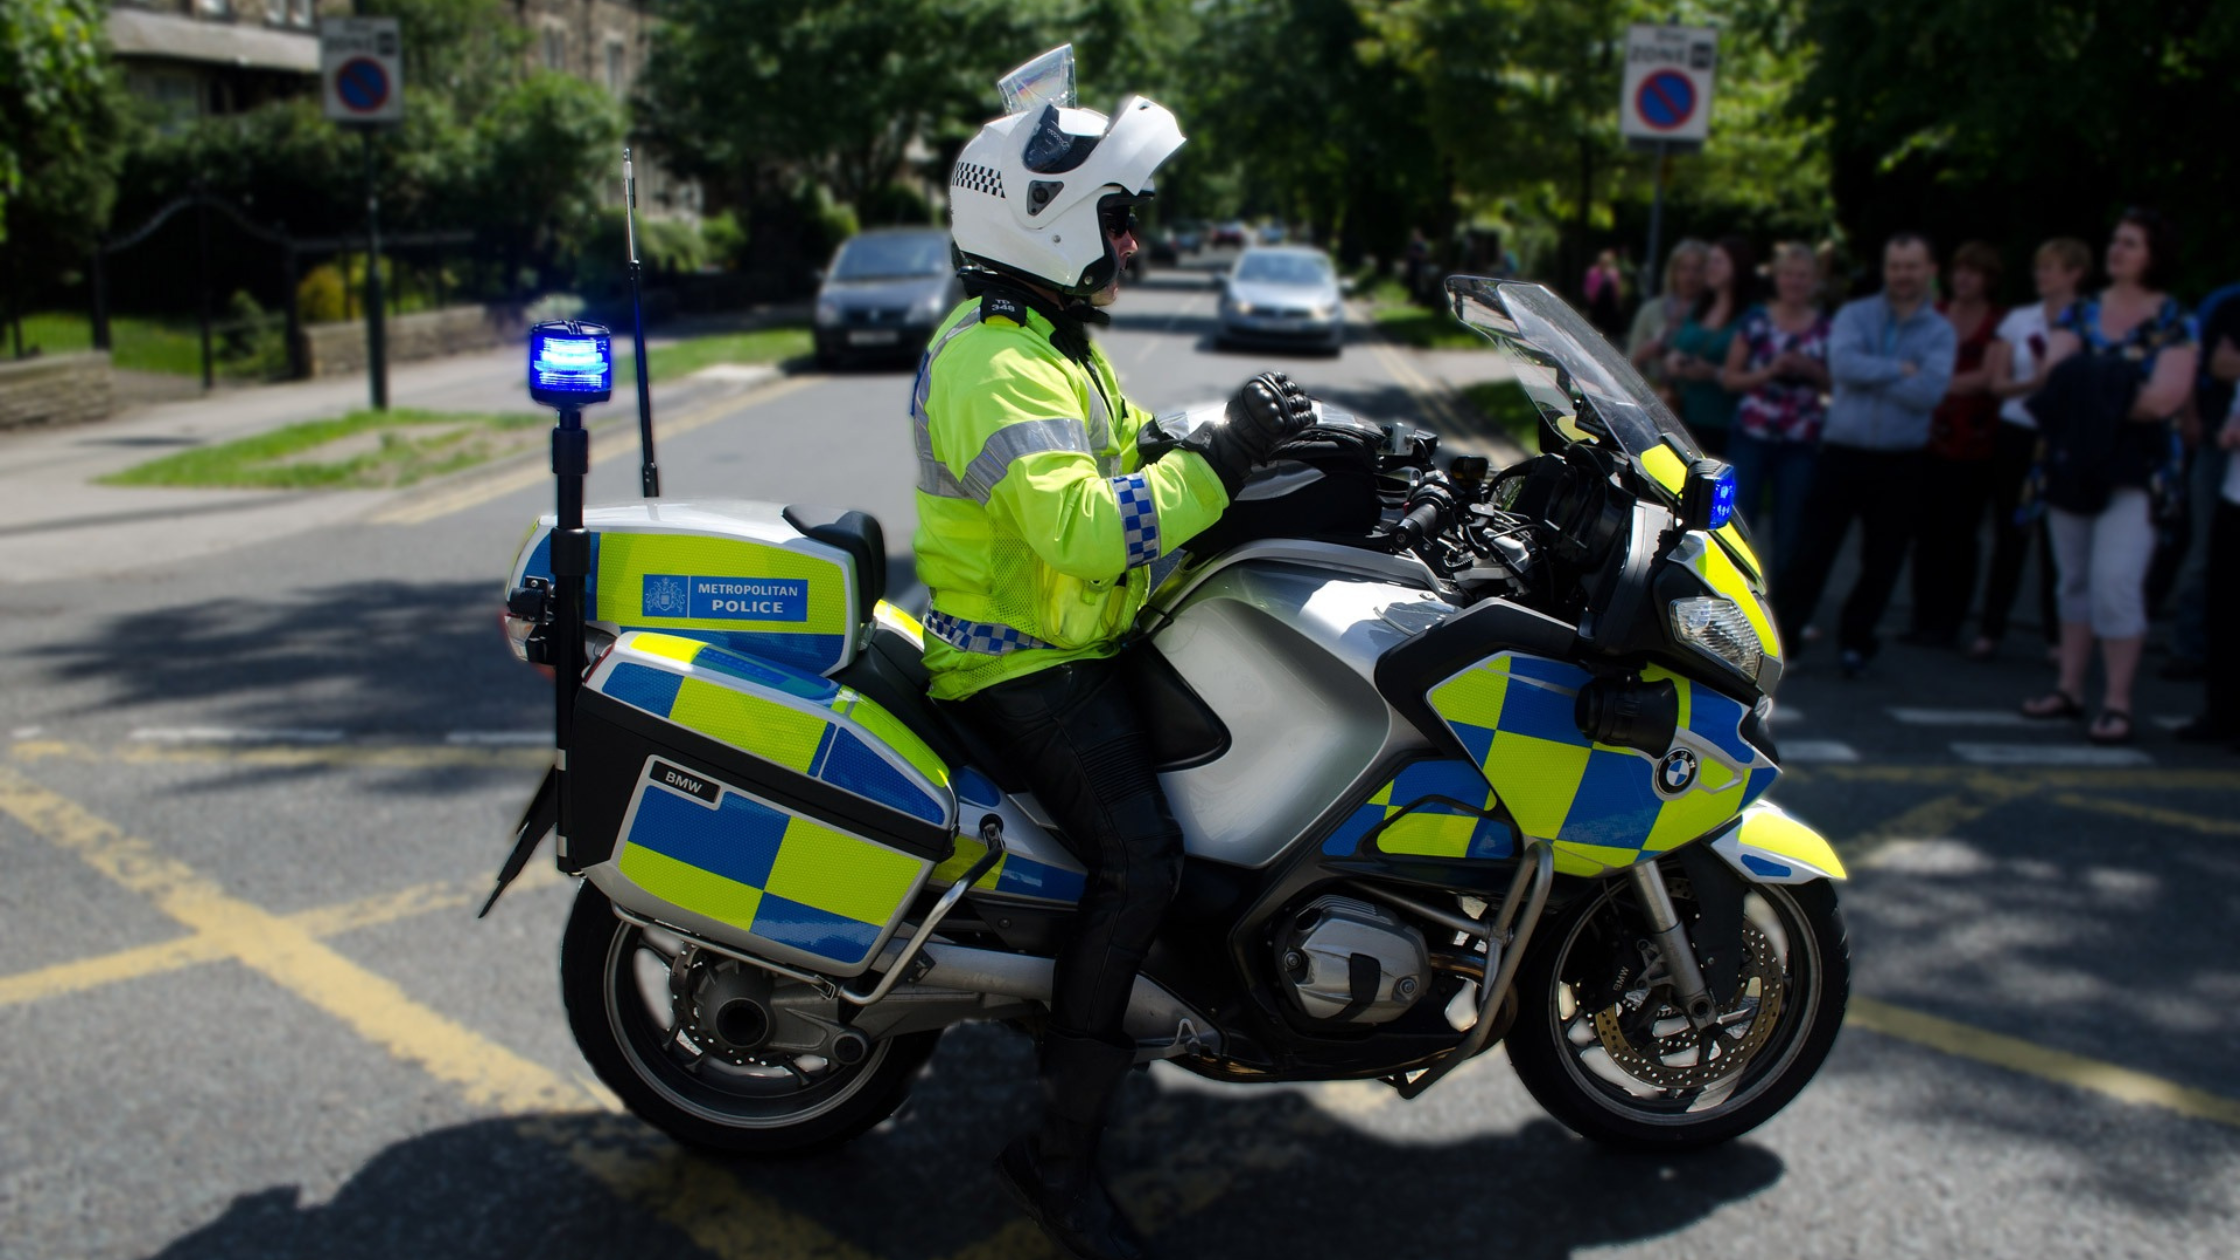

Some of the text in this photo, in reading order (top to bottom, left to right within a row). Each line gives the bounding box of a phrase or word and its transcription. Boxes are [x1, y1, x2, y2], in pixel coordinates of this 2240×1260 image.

[698, 583, 798, 597] METROPOLITAN
[712, 600, 783, 614] POLICE
[665, 771, 702, 793] BMW
[1612, 965, 1630, 991] BMW
